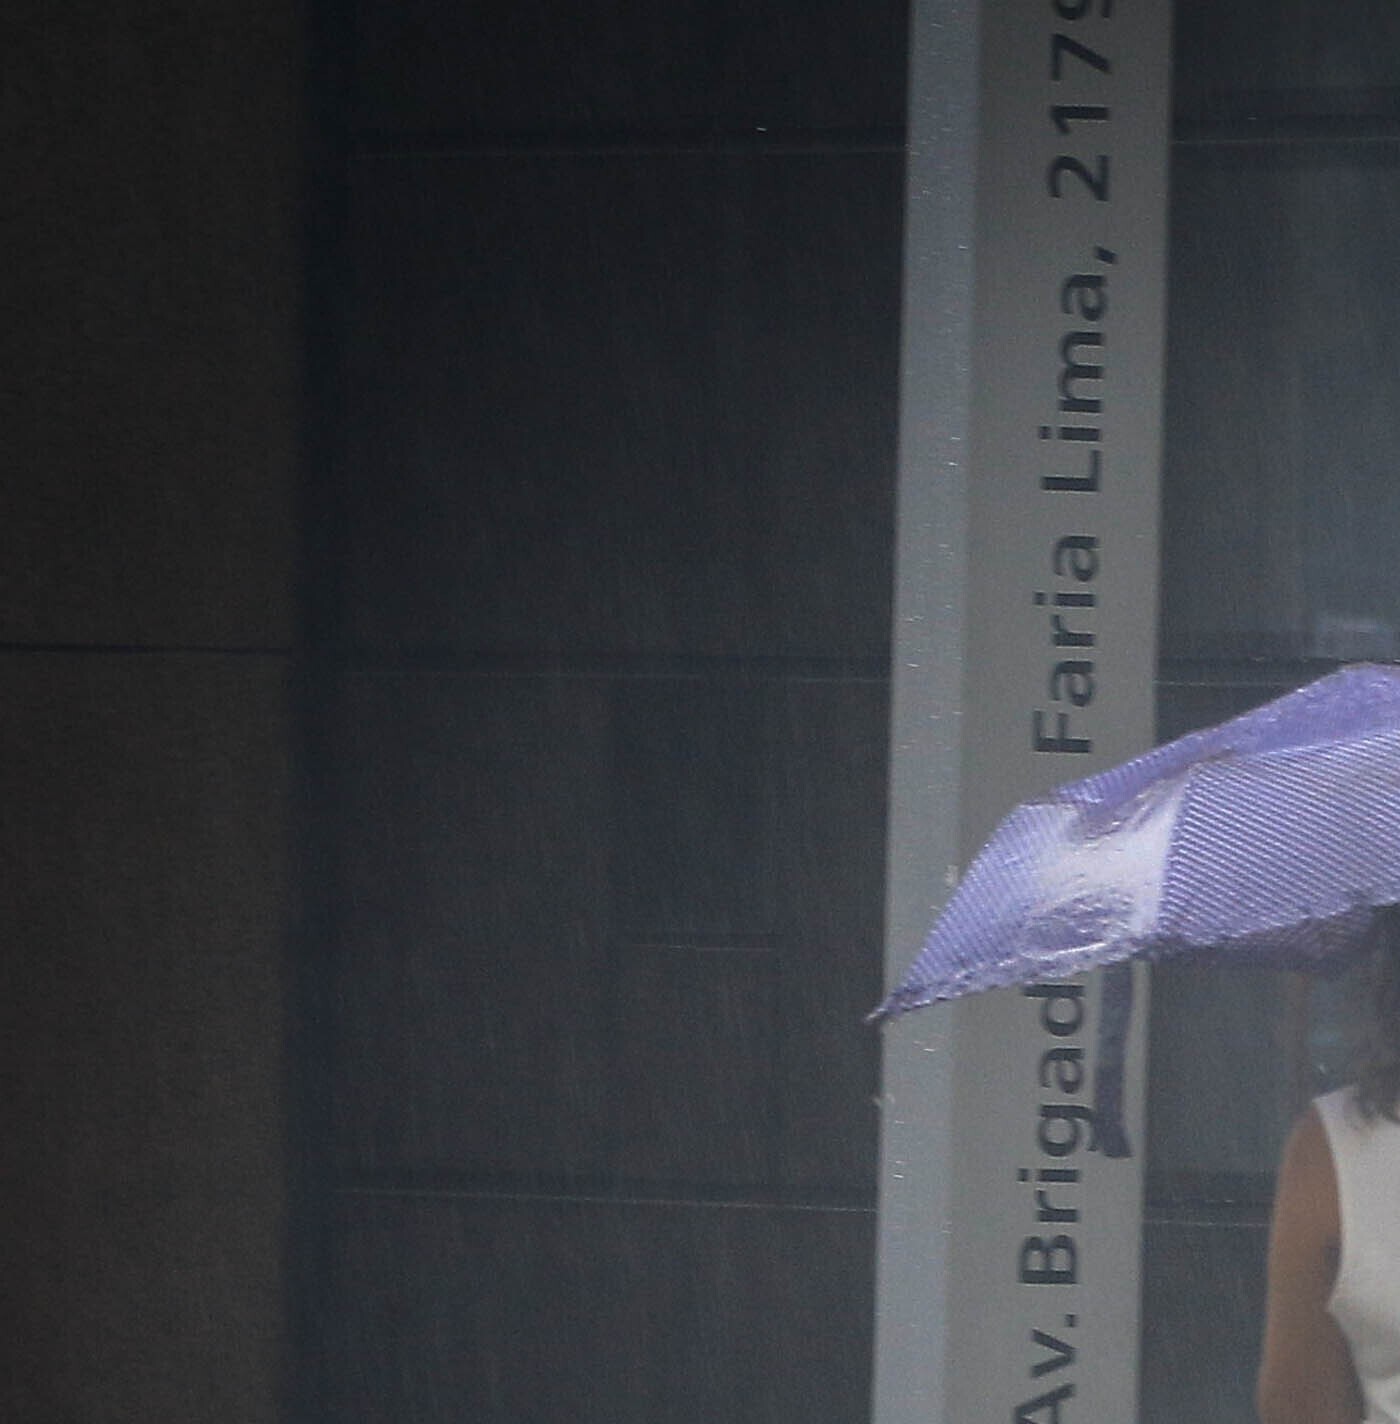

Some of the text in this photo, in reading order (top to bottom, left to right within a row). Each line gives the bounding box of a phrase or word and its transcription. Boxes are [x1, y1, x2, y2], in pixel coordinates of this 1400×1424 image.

[1037, 244, 1119, 494] Lima,
[1033, 534, 1098, 755] Faria
[1018, 982, 1099, 1287] Brigad
